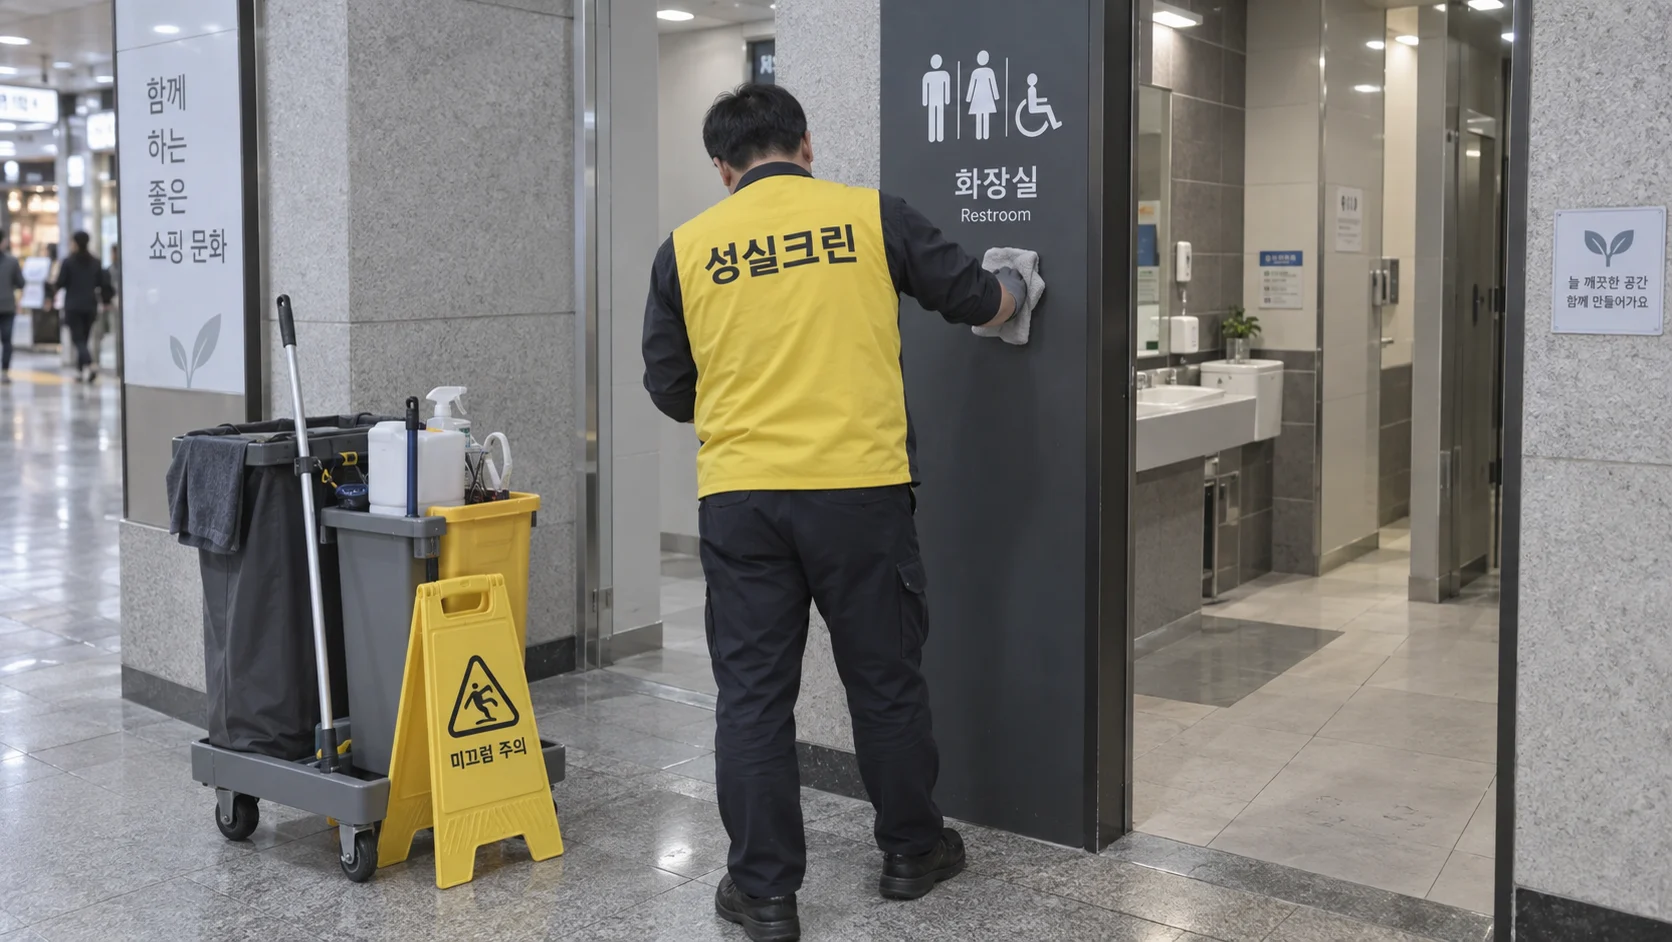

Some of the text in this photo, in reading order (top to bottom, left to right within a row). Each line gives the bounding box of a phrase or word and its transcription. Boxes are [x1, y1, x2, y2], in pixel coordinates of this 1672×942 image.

[147, 74, 186, 115] 함께
[148, 128, 187, 164] 하는
[148, 179, 188, 216] 좋은
[955, 165, 1037, 200] 화장실
[961, 208, 1031, 222] Restroom
[149, 228, 227, 264] 쇼핑 문화
[705, 224, 857, 285] 성실크린
[1568, 275, 1648, 290] 늘 깨끗한 공간
[1567, 295, 1648, 309] 함께 만들어가요
[450, 737, 527, 770] 미끄럼 주의
